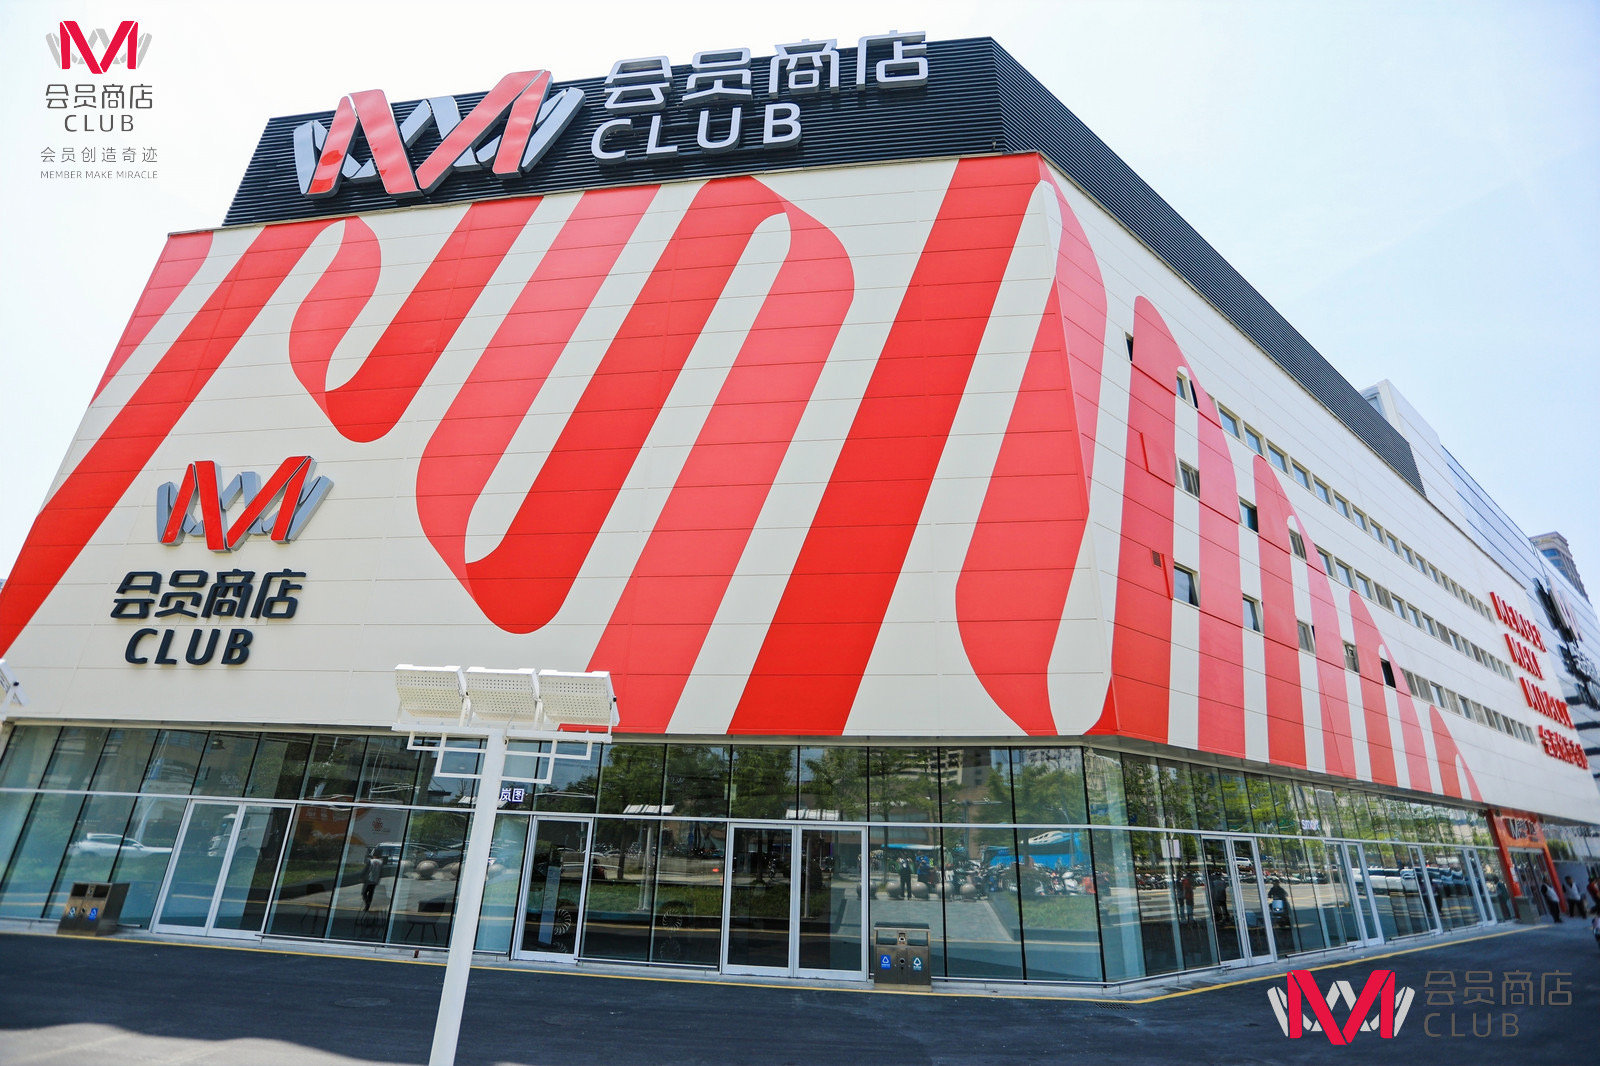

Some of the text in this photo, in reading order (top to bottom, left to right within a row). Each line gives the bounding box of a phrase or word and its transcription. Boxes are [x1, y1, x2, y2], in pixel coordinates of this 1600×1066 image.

[604, 30, 929, 114] 会员商店
[590, 102, 803, 164] CLUB
[110, 568, 307, 619] 会员商店
[124, 627, 254, 665] CLUB
